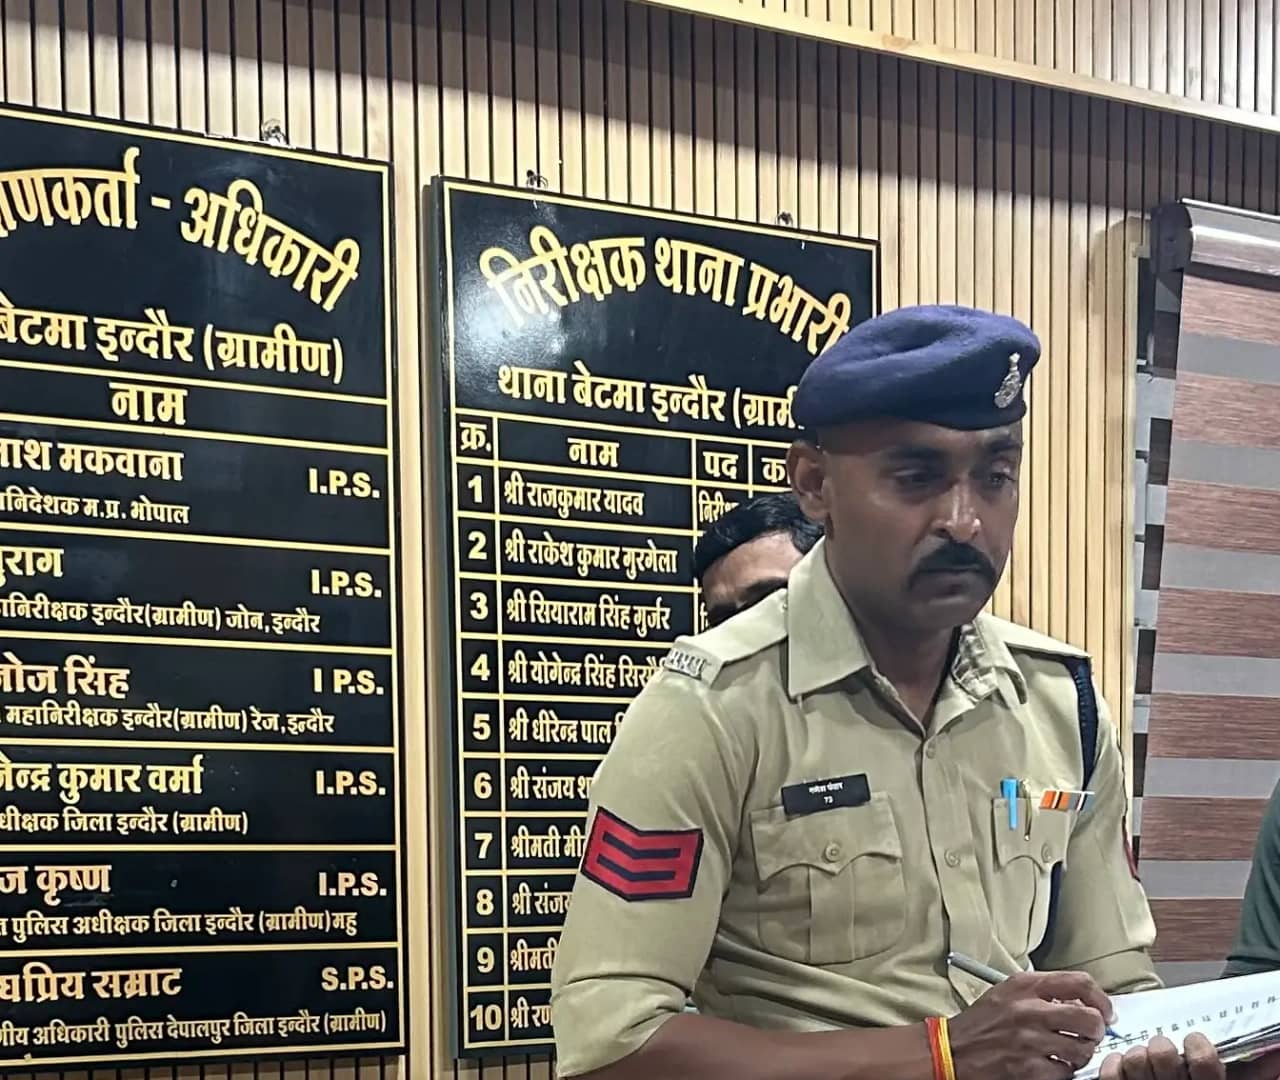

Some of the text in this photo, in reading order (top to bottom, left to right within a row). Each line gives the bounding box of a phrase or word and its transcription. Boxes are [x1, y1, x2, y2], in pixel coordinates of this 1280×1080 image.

[180, 179, 361, 313] अधिकारी
[479, 225, 853, 357] निरीक्षक थाना प्रभारी
[93, 308, 194, 362] इन्दौर
[203, 323, 344, 384] (ग्रामीण)
[108, 381, 188, 425] नाम
[498, 364, 567, 404] थाना
[571, 360, 646, 413] बेटमा
[650, 374, 726, 423] इन्दौर
[57, 441, 185, 481] मकवाना
[308, 467, 381, 498] I.P.S.
[459, 422, 492, 452] क्र.
[567, 437, 619, 468] नाम
[703, 451, 739, 479] पद
[82, 497, 127, 521] म.प्र.
[130, 495, 191, 524] भोपाल
[467, 475, 483, 503] 1
[504, 470, 524, 505] श्री
[526, 480, 602, 519] राजकुमार
[603, 488, 644, 516] यादव
[468, 527, 678, 580] 2 श्री राकेश कुमार गुरगेला
[311, 568, 383, 598] I.P.S.
[470, 591, 489, 620] 3
[506, 588, 527, 624] श्री
[530, 590, 597, 627] सियाराम
[599, 594, 630, 630] सिंह
[633, 596, 671, 637] गुर्जर
[63, 654, 130, 699] सिंह
[470, 653, 490, 681] 4
[507, 649, 528, 685] श्री
[530, 651, 581, 686] योगेन्द्र
[584, 653, 616, 689] सिंह
[5, 698, 119, 727] महानिरीक्षक
[473, 713, 491, 740] 5
[508, 708, 528, 742] श्री
[532, 709, 579, 743] धीरेन्द्र
[580, 720, 612, 744] पाल
[56, 763, 142, 804] कुमार
[146, 753, 204, 794] वर्मा
[315, 770, 386, 795] I.P.S.
[474, 772, 493, 799] 6
[509, 765, 530, 800] श्री
[532, 766, 575, 799] संजय
[62, 806, 113, 832] जिला
[116, 806, 169, 835] इन्दौर
[172, 806, 249, 835] (ग्रामीण)
[474, 833, 494, 859] 7
[511, 825, 561, 858] श्रीमती
[34, 864, 112, 906] कृष्ण
[318, 871, 388, 897] I.P.S.
[476, 889, 494, 915] 8
[512, 882, 532, 915] श्री
[11, 909, 69, 943] पुलिस
[72, 908, 149, 935] अधीक्षक
[153, 907, 201, 933] जिला
[205, 906, 255, 935] इन्दौर
[477, 937, 559, 973] 9 श्रीमती
[91, 967, 182, 999] सम्राट
[321, 965, 395, 991] S.P.S.
[32, 1016, 110, 1046] अधिकारी
[114, 1016, 164, 1048] पुलिस
[167, 1014, 231, 1044] देपालपुर
[233, 1011, 274, 1036] जिला
[278, 1009, 320, 1038] इन्दौर
[323, 1007, 387, 1034] (ग्रामीण)
[470, 1004, 502, 1031] 10
[510, 996, 530, 1028] श्री
